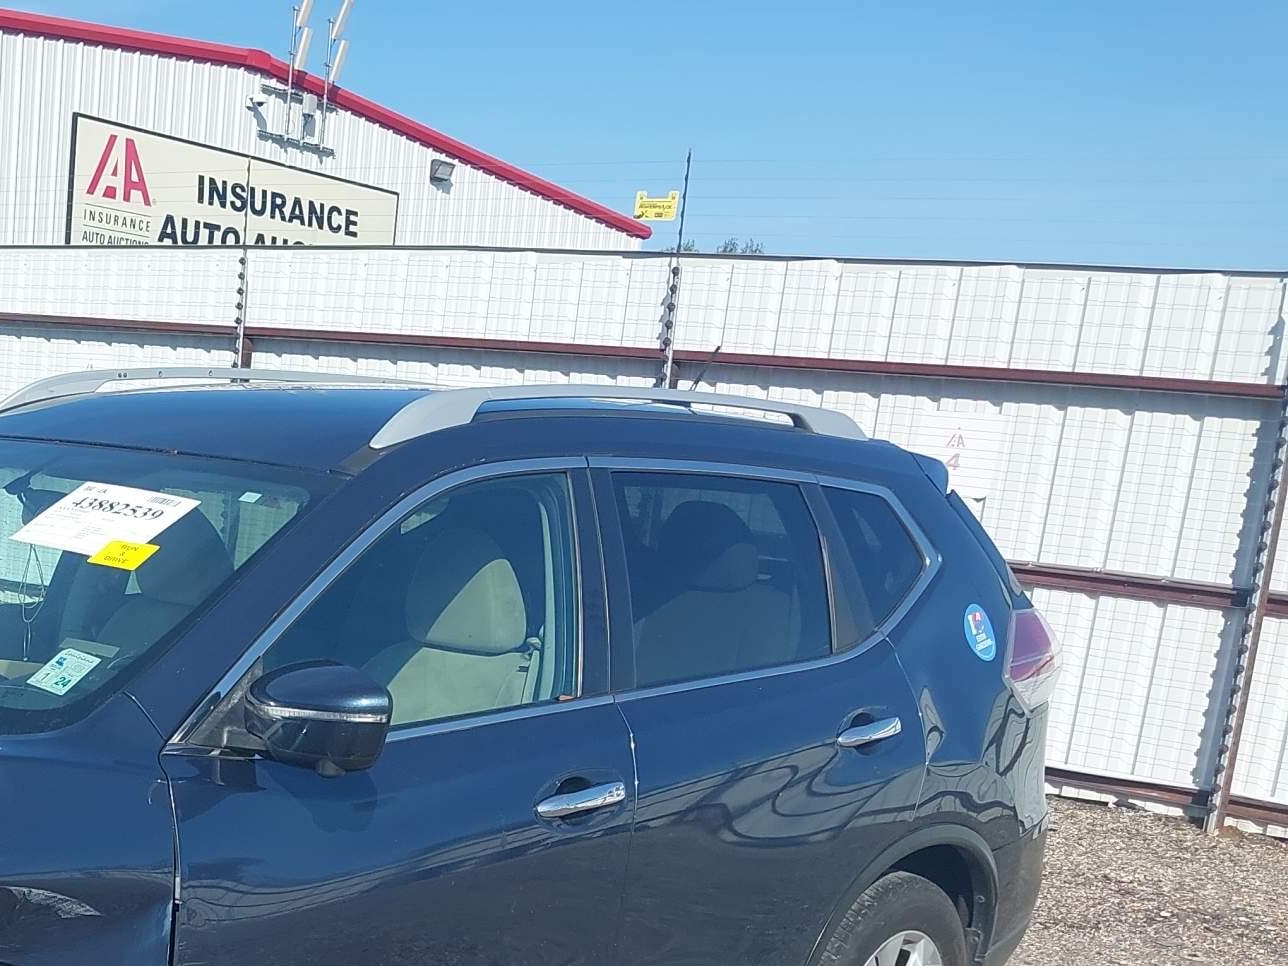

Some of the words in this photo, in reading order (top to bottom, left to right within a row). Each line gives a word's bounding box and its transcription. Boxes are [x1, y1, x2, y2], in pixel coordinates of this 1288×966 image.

[197, 174, 359, 238] INSURANCE
[83, 208, 151, 233] INSURANCE
[157, 213, 241, 246] AUTO
[82, 230, 105, 245] AUTO
[72, 496, 165, 521] 43882539
